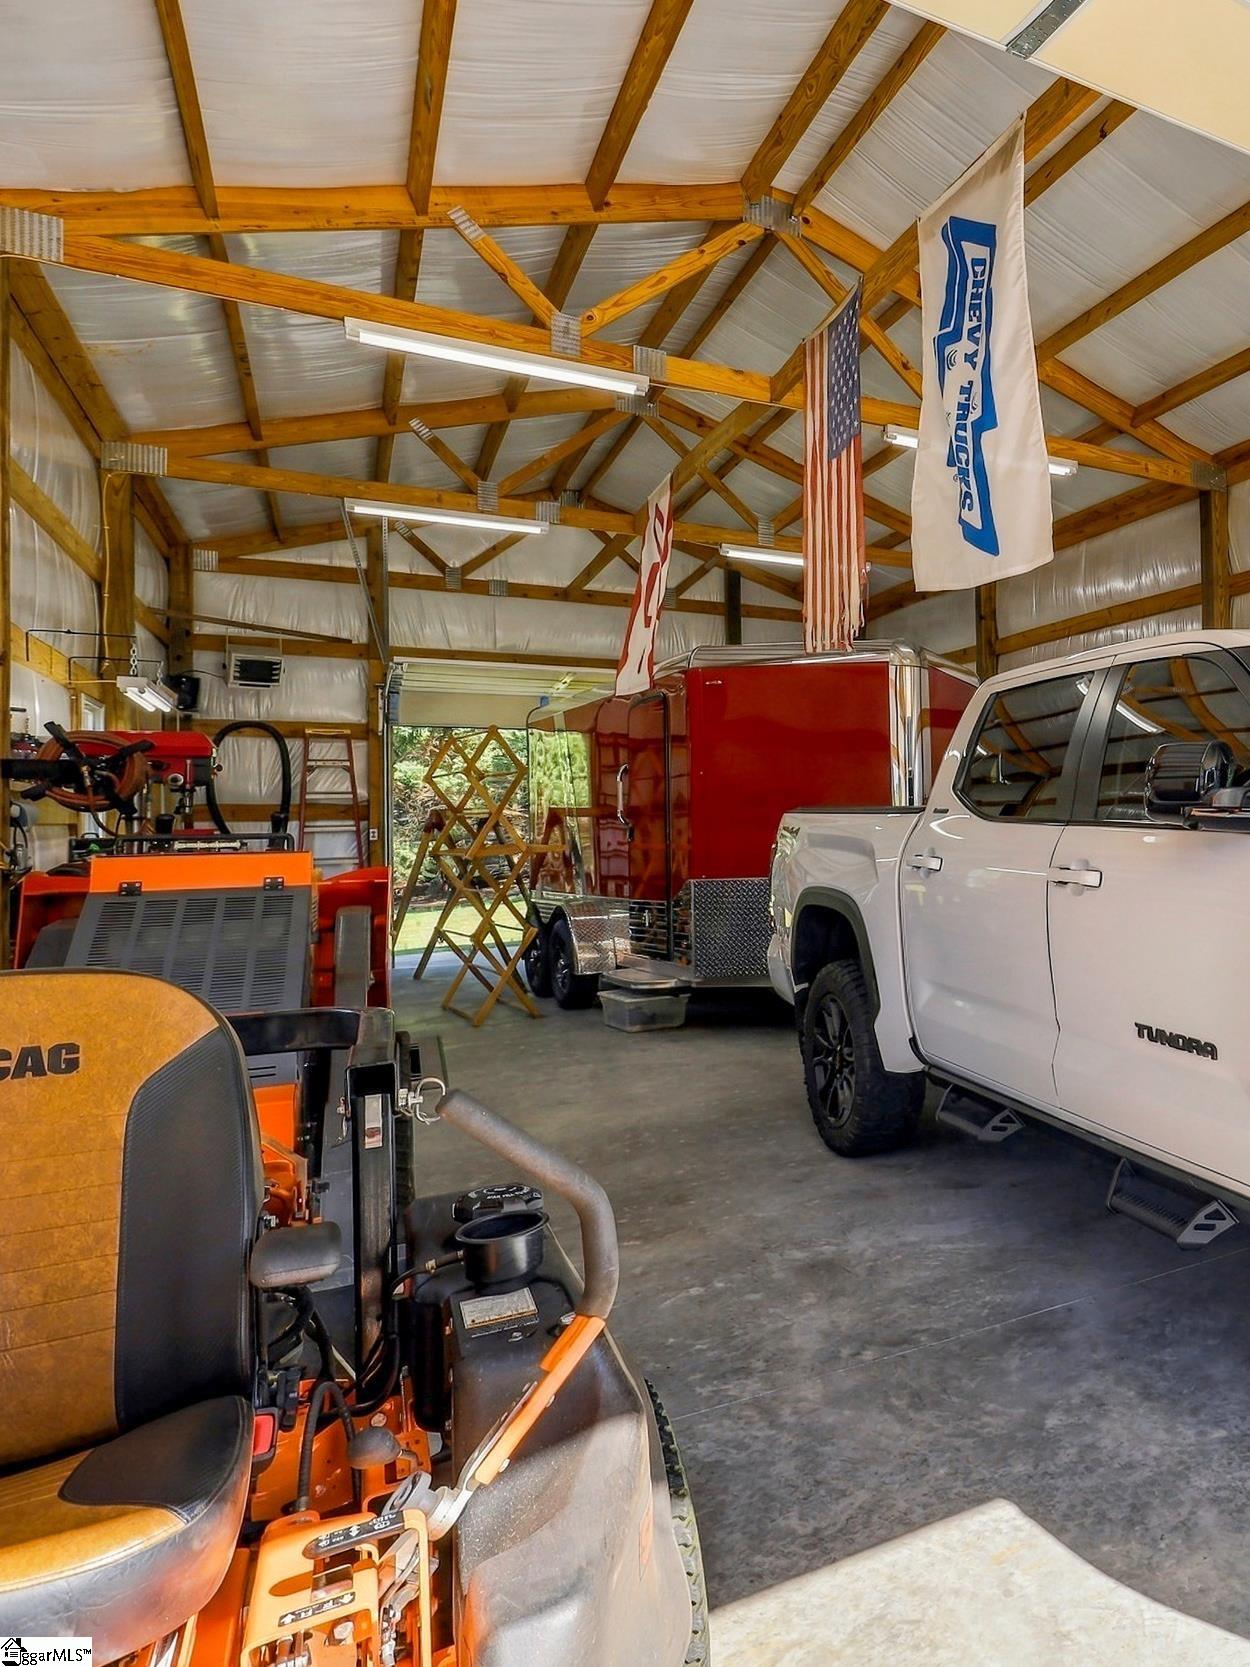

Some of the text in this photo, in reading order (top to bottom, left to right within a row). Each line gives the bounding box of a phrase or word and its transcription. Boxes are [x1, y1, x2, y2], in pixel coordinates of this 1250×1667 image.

[954, 257, 986, 512] CHEVY TRUCKS
[1134, 1021, 1218, 1061] TUNDRA
